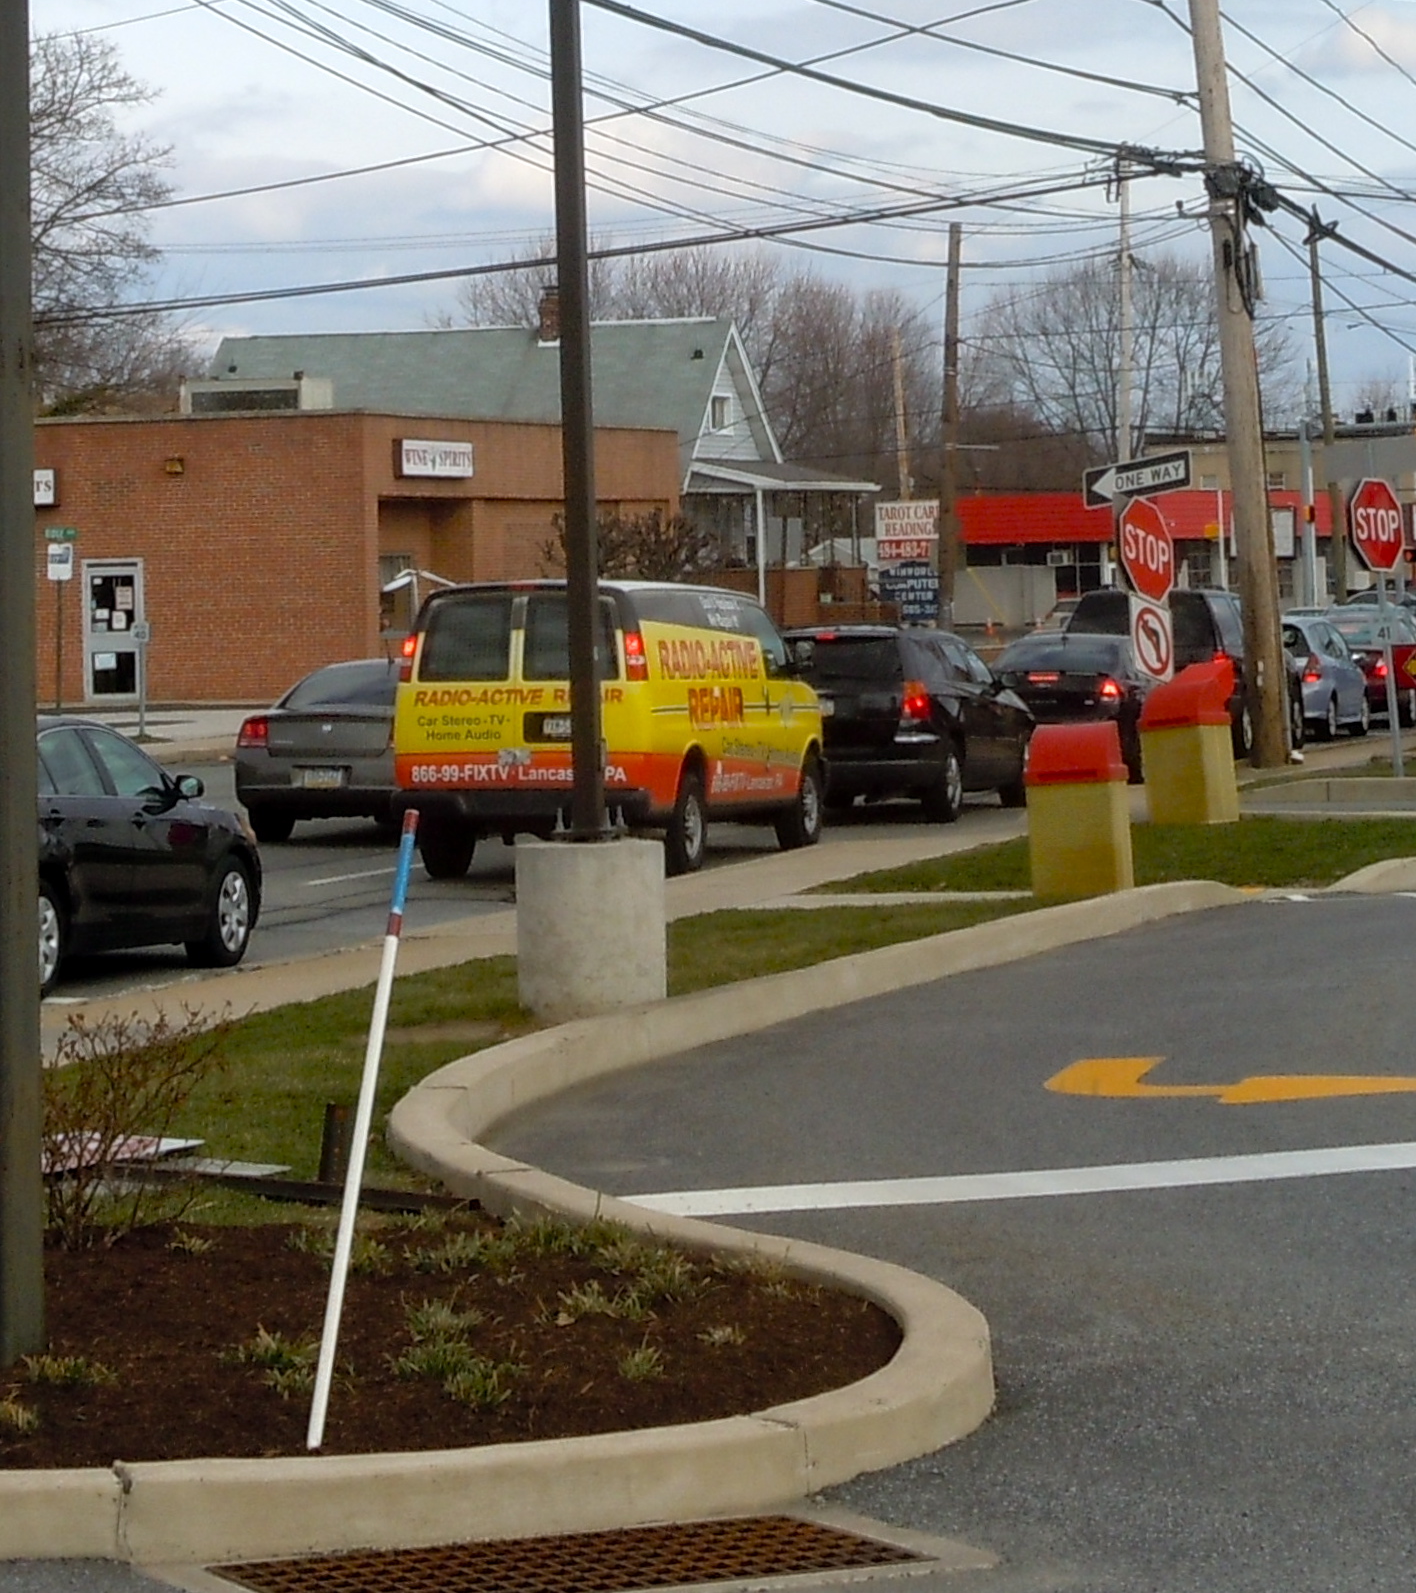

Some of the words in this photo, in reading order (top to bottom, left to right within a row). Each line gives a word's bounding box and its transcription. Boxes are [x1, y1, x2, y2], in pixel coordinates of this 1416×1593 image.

[1115, 471, 1144, 490] ONE
[1151, 463, 1182, 482] WAY
[878, 506, 911, 521] TAROT
[1356, 507, 1399, 543] STOP
[1125, 523, 1169, 575] STOP
[658, 640, 759, 681] RADIO-ACTIVE
[414, 688, 544, 707] RADIO-ACTIVE
[553, 688, 624, 704] RIR
[688, 687, 744, 731] REPAIR
[417, 715, 438, 727] Car
[442, 715, 481, 727] Stereo
[426, 730, 461, 741] Home
[465, 729, 502, 741] Audio
[412, 765, 509, 783] 866-99-FIXTV
[518, 766, 574, 782] Lancas
[604, 766, 627, 782] PA
